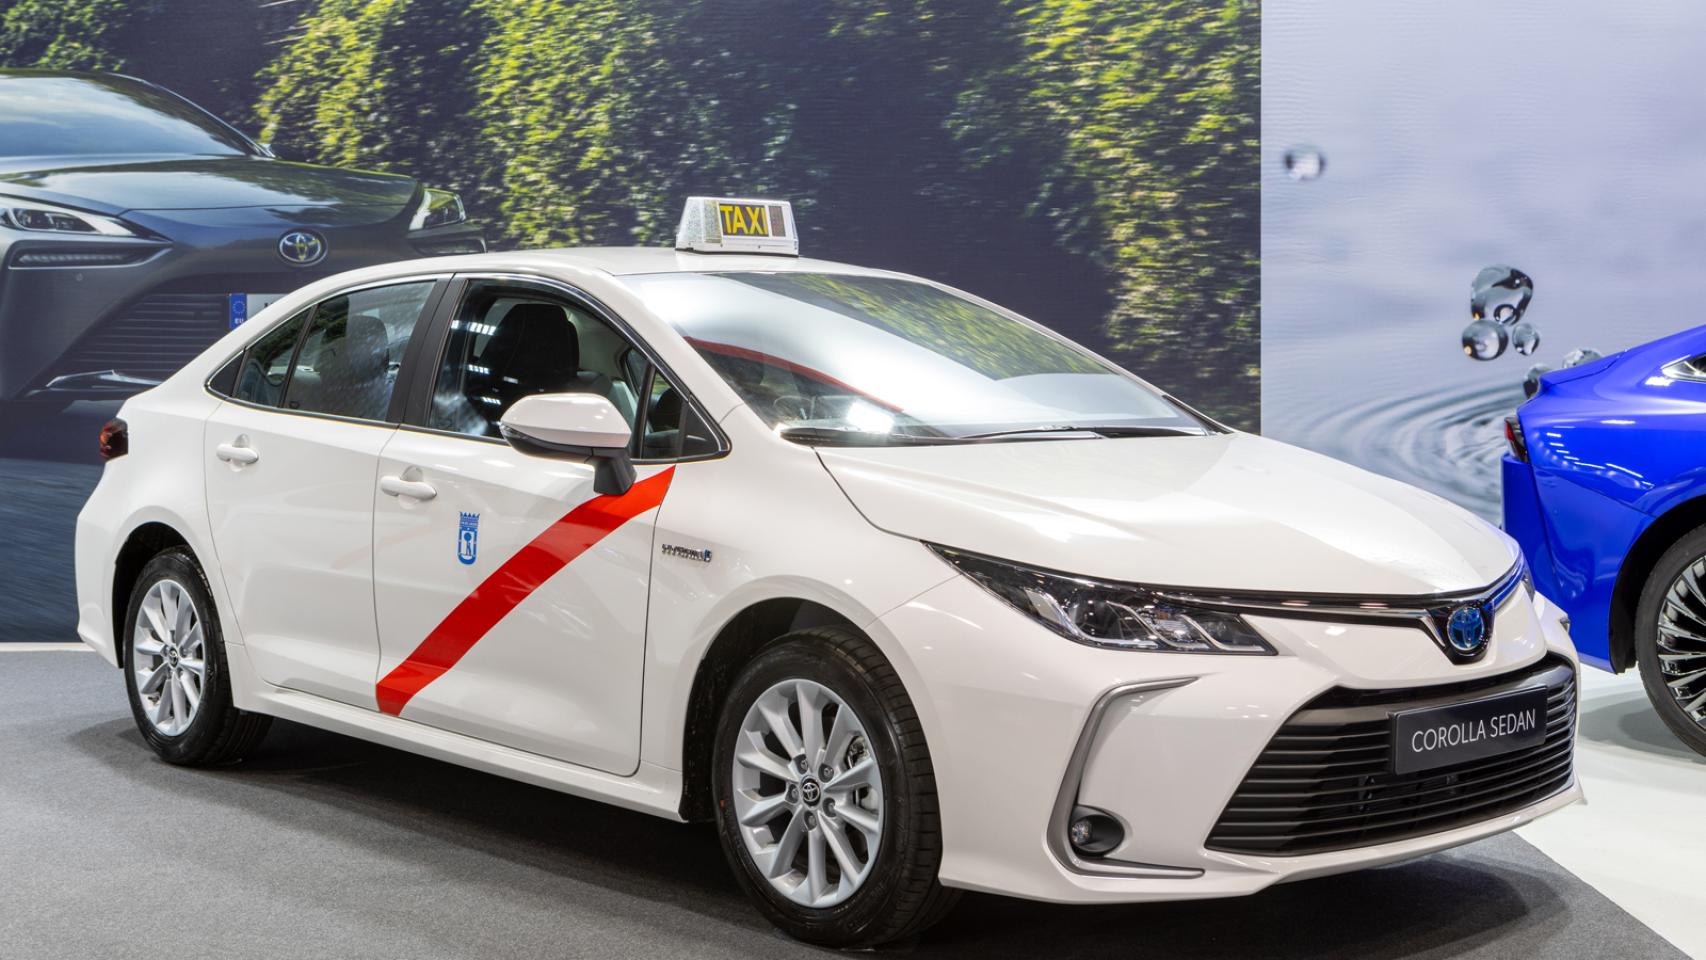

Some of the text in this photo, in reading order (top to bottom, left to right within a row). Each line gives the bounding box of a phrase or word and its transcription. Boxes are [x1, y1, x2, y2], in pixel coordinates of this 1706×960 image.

[720, 205, 768, 234] TAXI
[1411, 708, 1536, 753] COROLLA SEDAN
